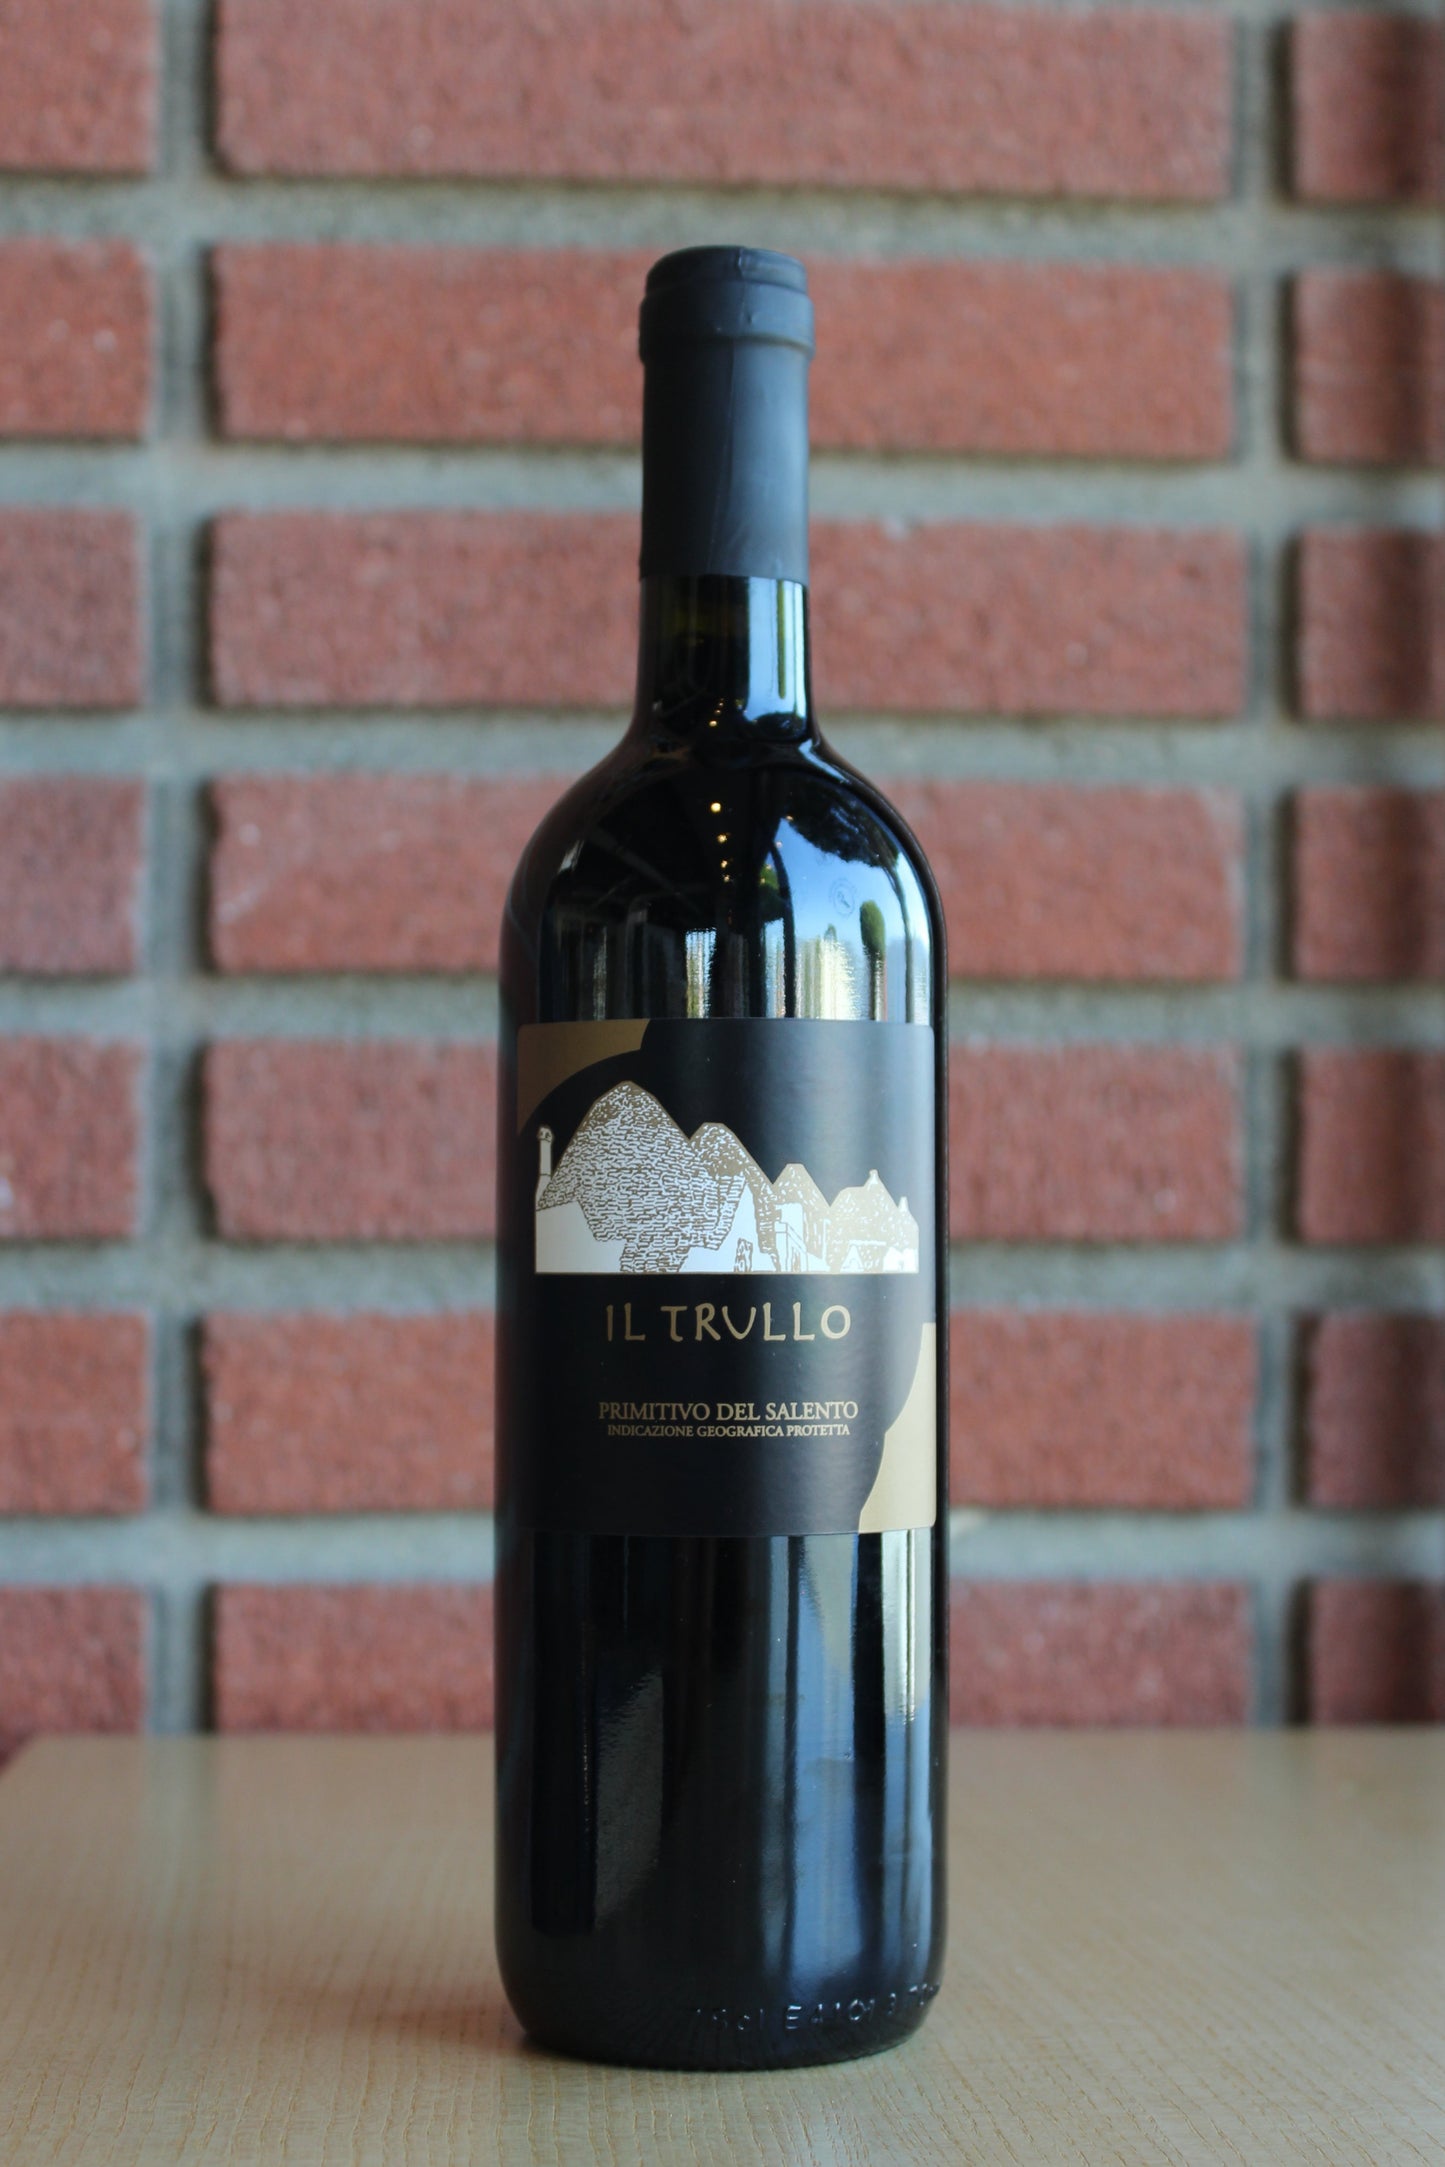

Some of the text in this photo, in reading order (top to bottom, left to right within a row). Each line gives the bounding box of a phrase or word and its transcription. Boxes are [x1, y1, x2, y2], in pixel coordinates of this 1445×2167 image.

[606, 1302, 851, 1341] IL TRULLO
[599, 1401, 858, 1421] PRIMITIVO DEL SALENTO
[607, 1424, 850, 1437] INDICAZIONE GEOGRAFICA PROTETTA
